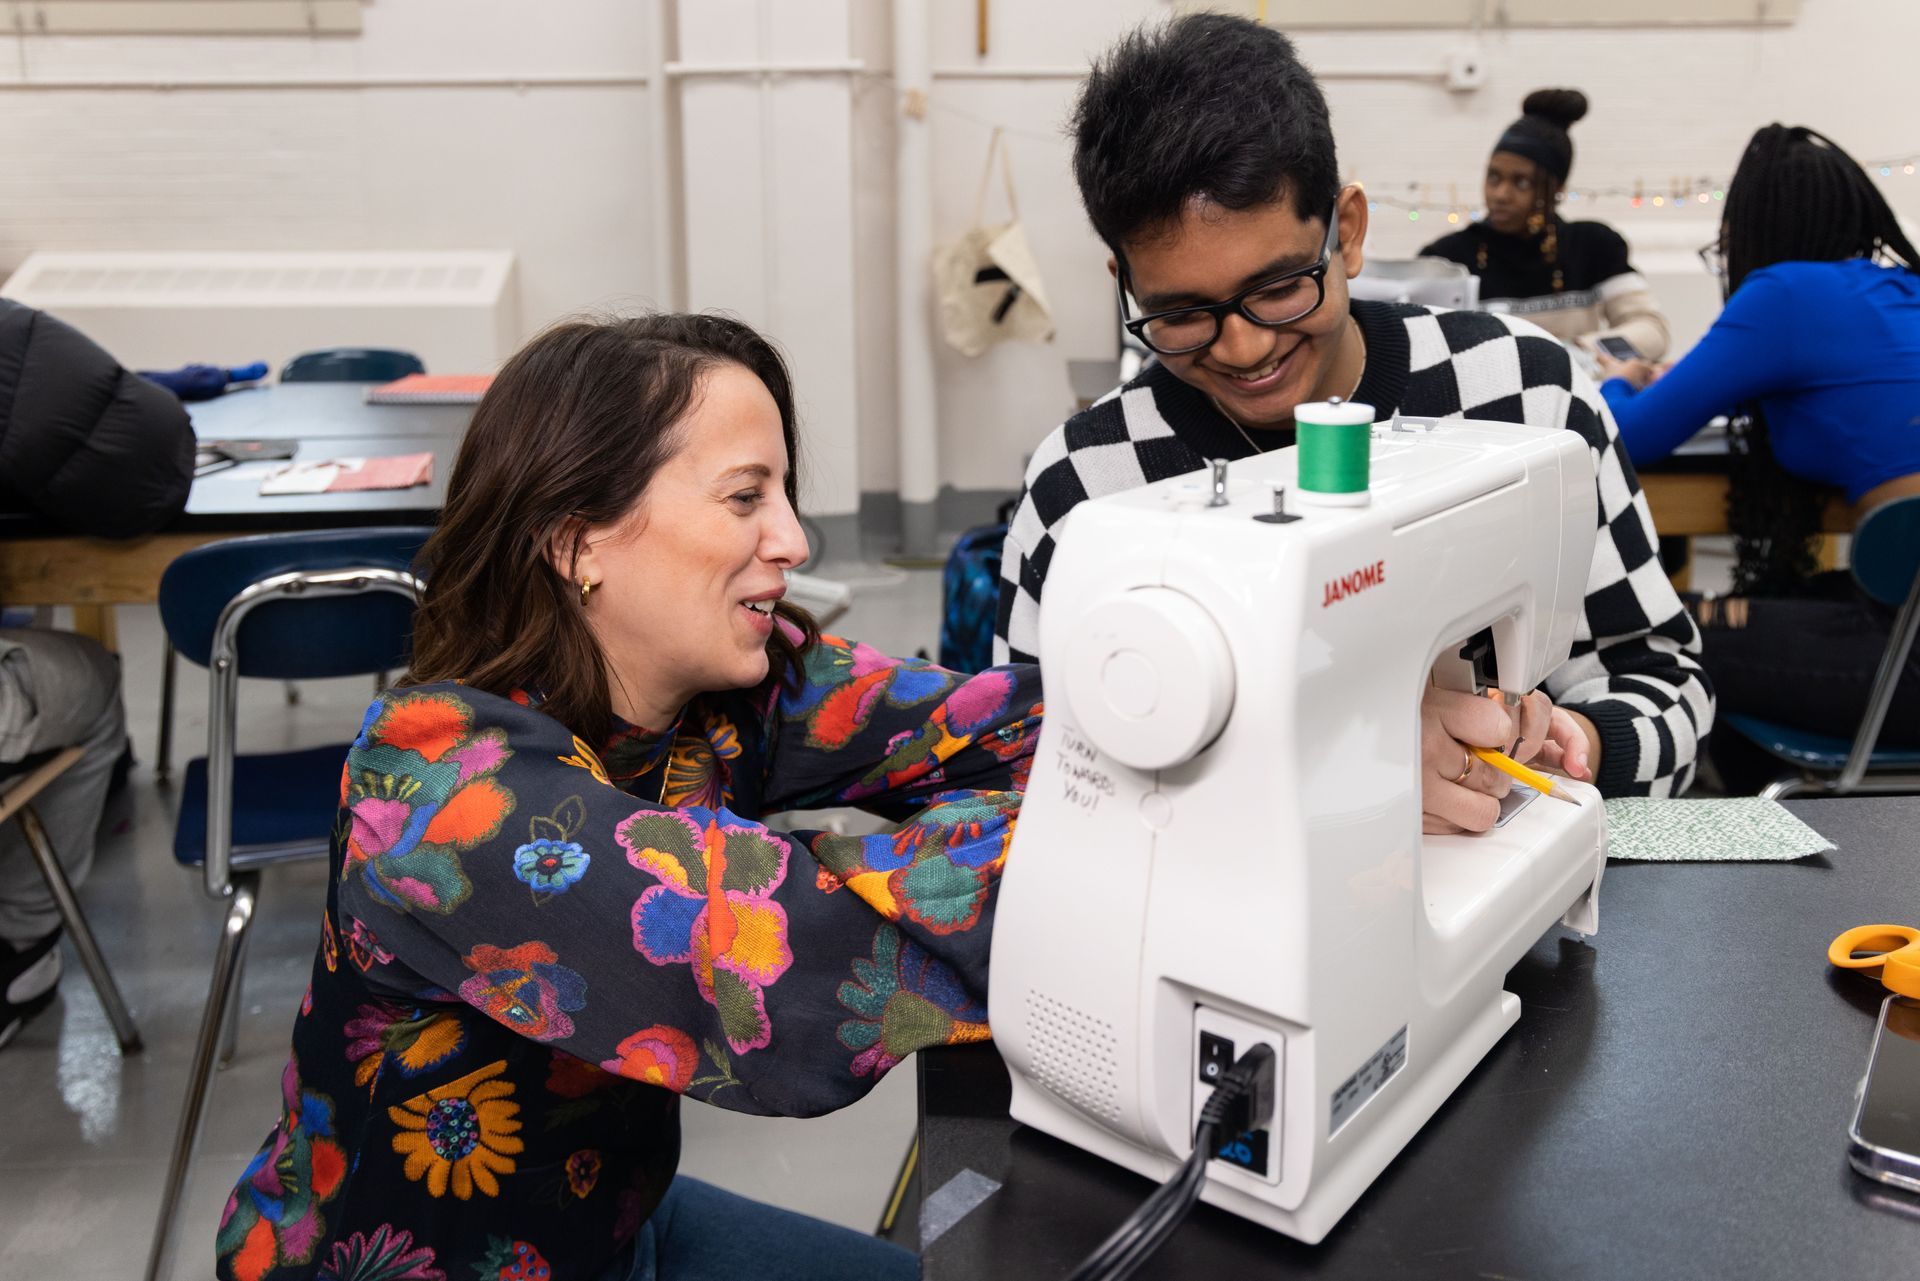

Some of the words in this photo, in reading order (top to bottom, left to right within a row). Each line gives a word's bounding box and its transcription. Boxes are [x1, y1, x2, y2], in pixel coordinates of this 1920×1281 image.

[1322, 559, 1385, 608] JANOME
[1060, 724, 1098, 762] TURN
[1063, 779, 1100, 816] YOU!
